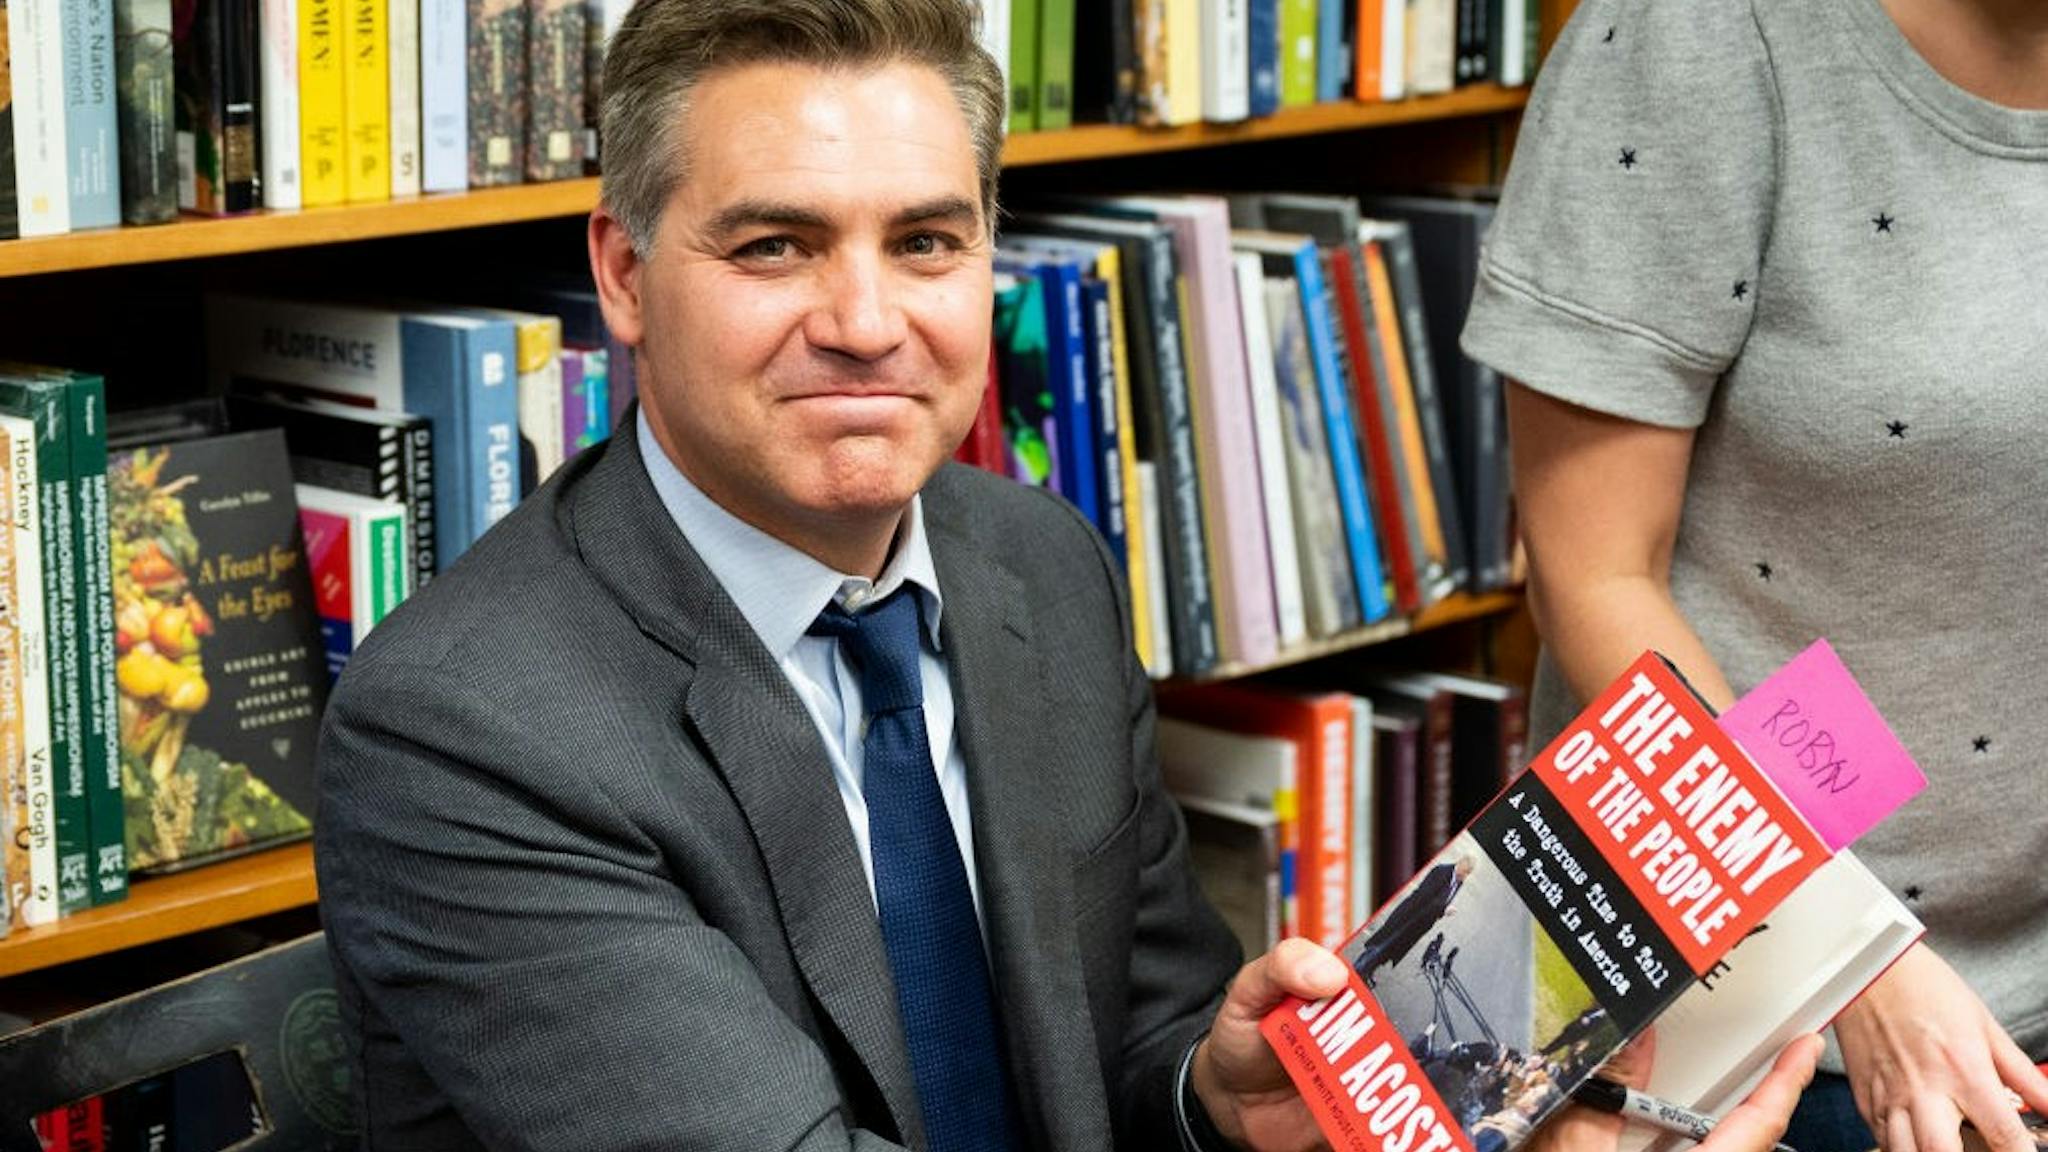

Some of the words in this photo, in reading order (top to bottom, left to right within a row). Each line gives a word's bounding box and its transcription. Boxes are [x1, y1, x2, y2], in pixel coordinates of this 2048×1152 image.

[90, 34, 105, 104] Nation
[262, 327, 376, 370] FLORENCE
[16, 438, 32, 532] Hockney
[81, 476, 95, 535] Highlights
[43, 482, 56, 541] Highlights
[95, 474, 111, 593] IMPRESSIONISM
[46, 542, 57, 569] from
[56, 481, 73, 599] IMPRESSIONISM
[85, 535, 96, 562] from
[48, 570, 58, 590] the
[86, 563, 97, 584] the
[199, 558, 215, 585] A
[219, 553, 266, 581] Feast
[267, 544, 297, 581] for
[47, 590, 62, 660] Philadelphia
[62, 602, 77, 636] AND
[86, 584, 101, 653] Philadelphia
[100, 595, 113, 629] AND
[218, 592, 247, 620] the
[252, 586, 293, 623] Eyes
[90, 654, 102, 702] Museum
[224, 653, 276, 674] EDIBLE
[281, 646, 307, 662] ART
[250, 670, 289, 687] FROM
[51, 661, 64, 710] Museum
[236, 687, 288, 711] APPLES
[55, 710, 65, 722] of
[92, 703, 103, 715] of
[92, 716, 104, 735] Art
[55, 723, 66, 743] Art
[32, 748, 45, 787] Van
[1599, 671, 1694, 777] THE
[1658, 743, 1804, 896] ENEMY
[28, 791, 49, 848] Gogh
[1553, 729, 1612, 784] OF
[1586, 764, 1655, 843] THE
[1627, 818, 1742, 946] PEOPLE
[1502, 828, 1527, 861] the
[1526, 858, 1565, 909] Truth
[1560, 906, 1583, 932] in
[1578, 930, 1632, 997] America
[1508, 791, 1526, 810] A
[1522, 804, 1588, 885] Dangerous
[1586, 882, 1618, 924] Time
[1616, 923, 1637, 948] to
[1635, 945, 1670, 989] Tell
[1312, 1071, 1336, 1103] WHITE
[1330, 1100, 1355, 1138] HOUSE
[1339, 1041, 1465, 1152] ACOST
